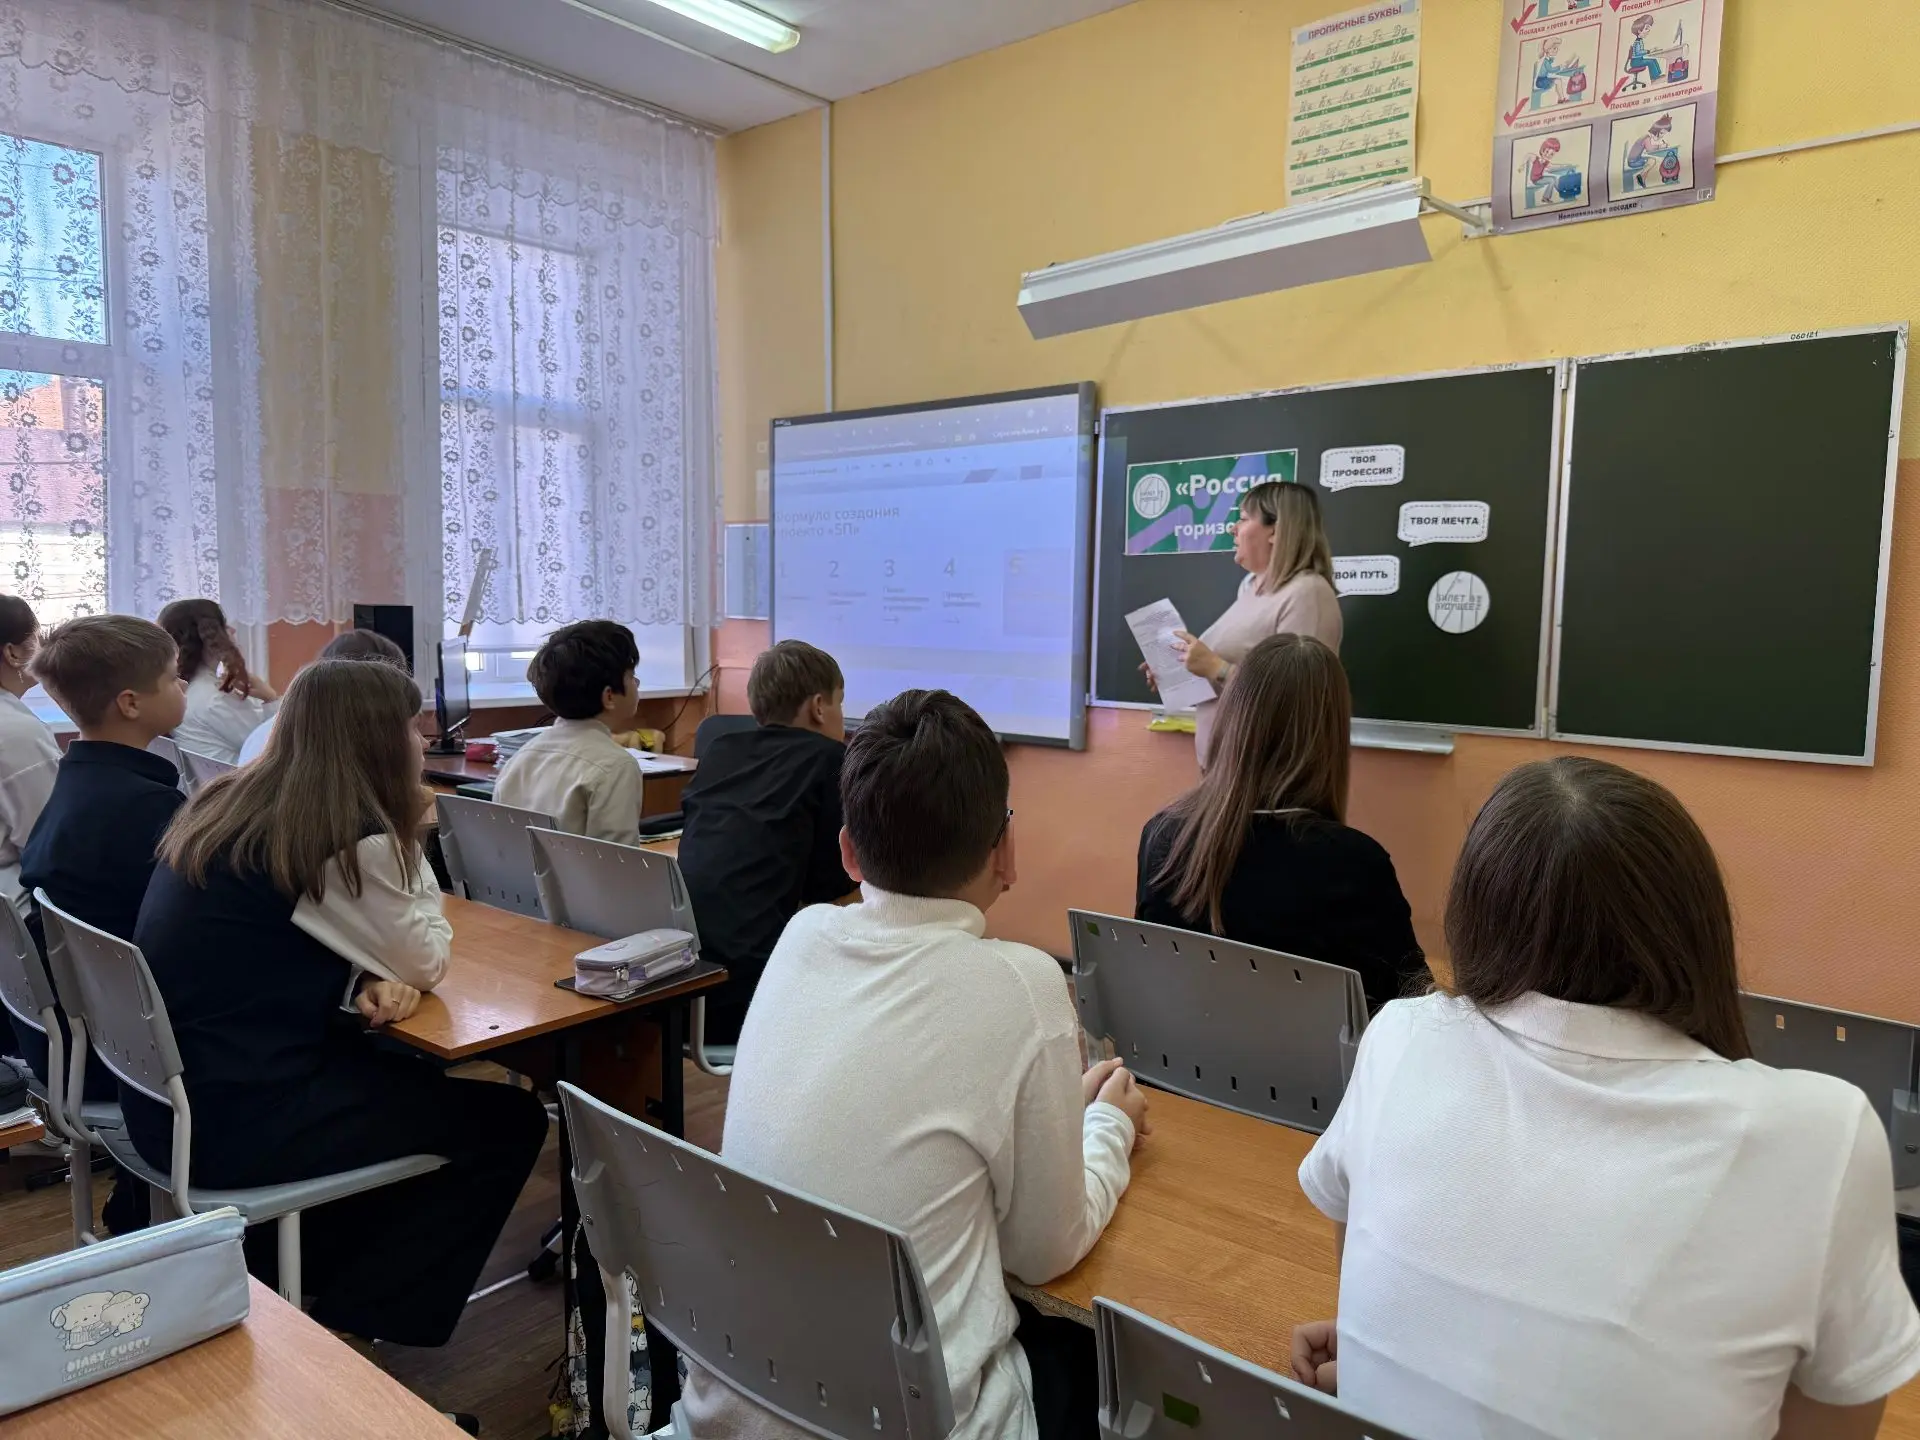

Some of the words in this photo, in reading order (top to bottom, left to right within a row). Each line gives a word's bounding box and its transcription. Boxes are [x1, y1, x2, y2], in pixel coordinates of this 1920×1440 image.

[1308, 14, 1367, 40] ПРОПИСНЫЕ
[1367, 5, 1402, 23] БУКВЫ
[1609, 100, 1640, 110] Посадка
[1350, 455, 1376, 464] ТВОЯ
[1332, 466, 1392, 477] ПРОФЕССИЯ
[1410, 517, 1438, 525] ТВОЯ
[1441, 516, 1479, 525] МЕЧТА
[1174, 522, 1237, 540] горизо
[828, 560, 839, 578] 2
[884, 559, 895, 578] 3
[943, 557, 956, 578] 4
[1360, 570, 1388, 579] ПУТЬ
